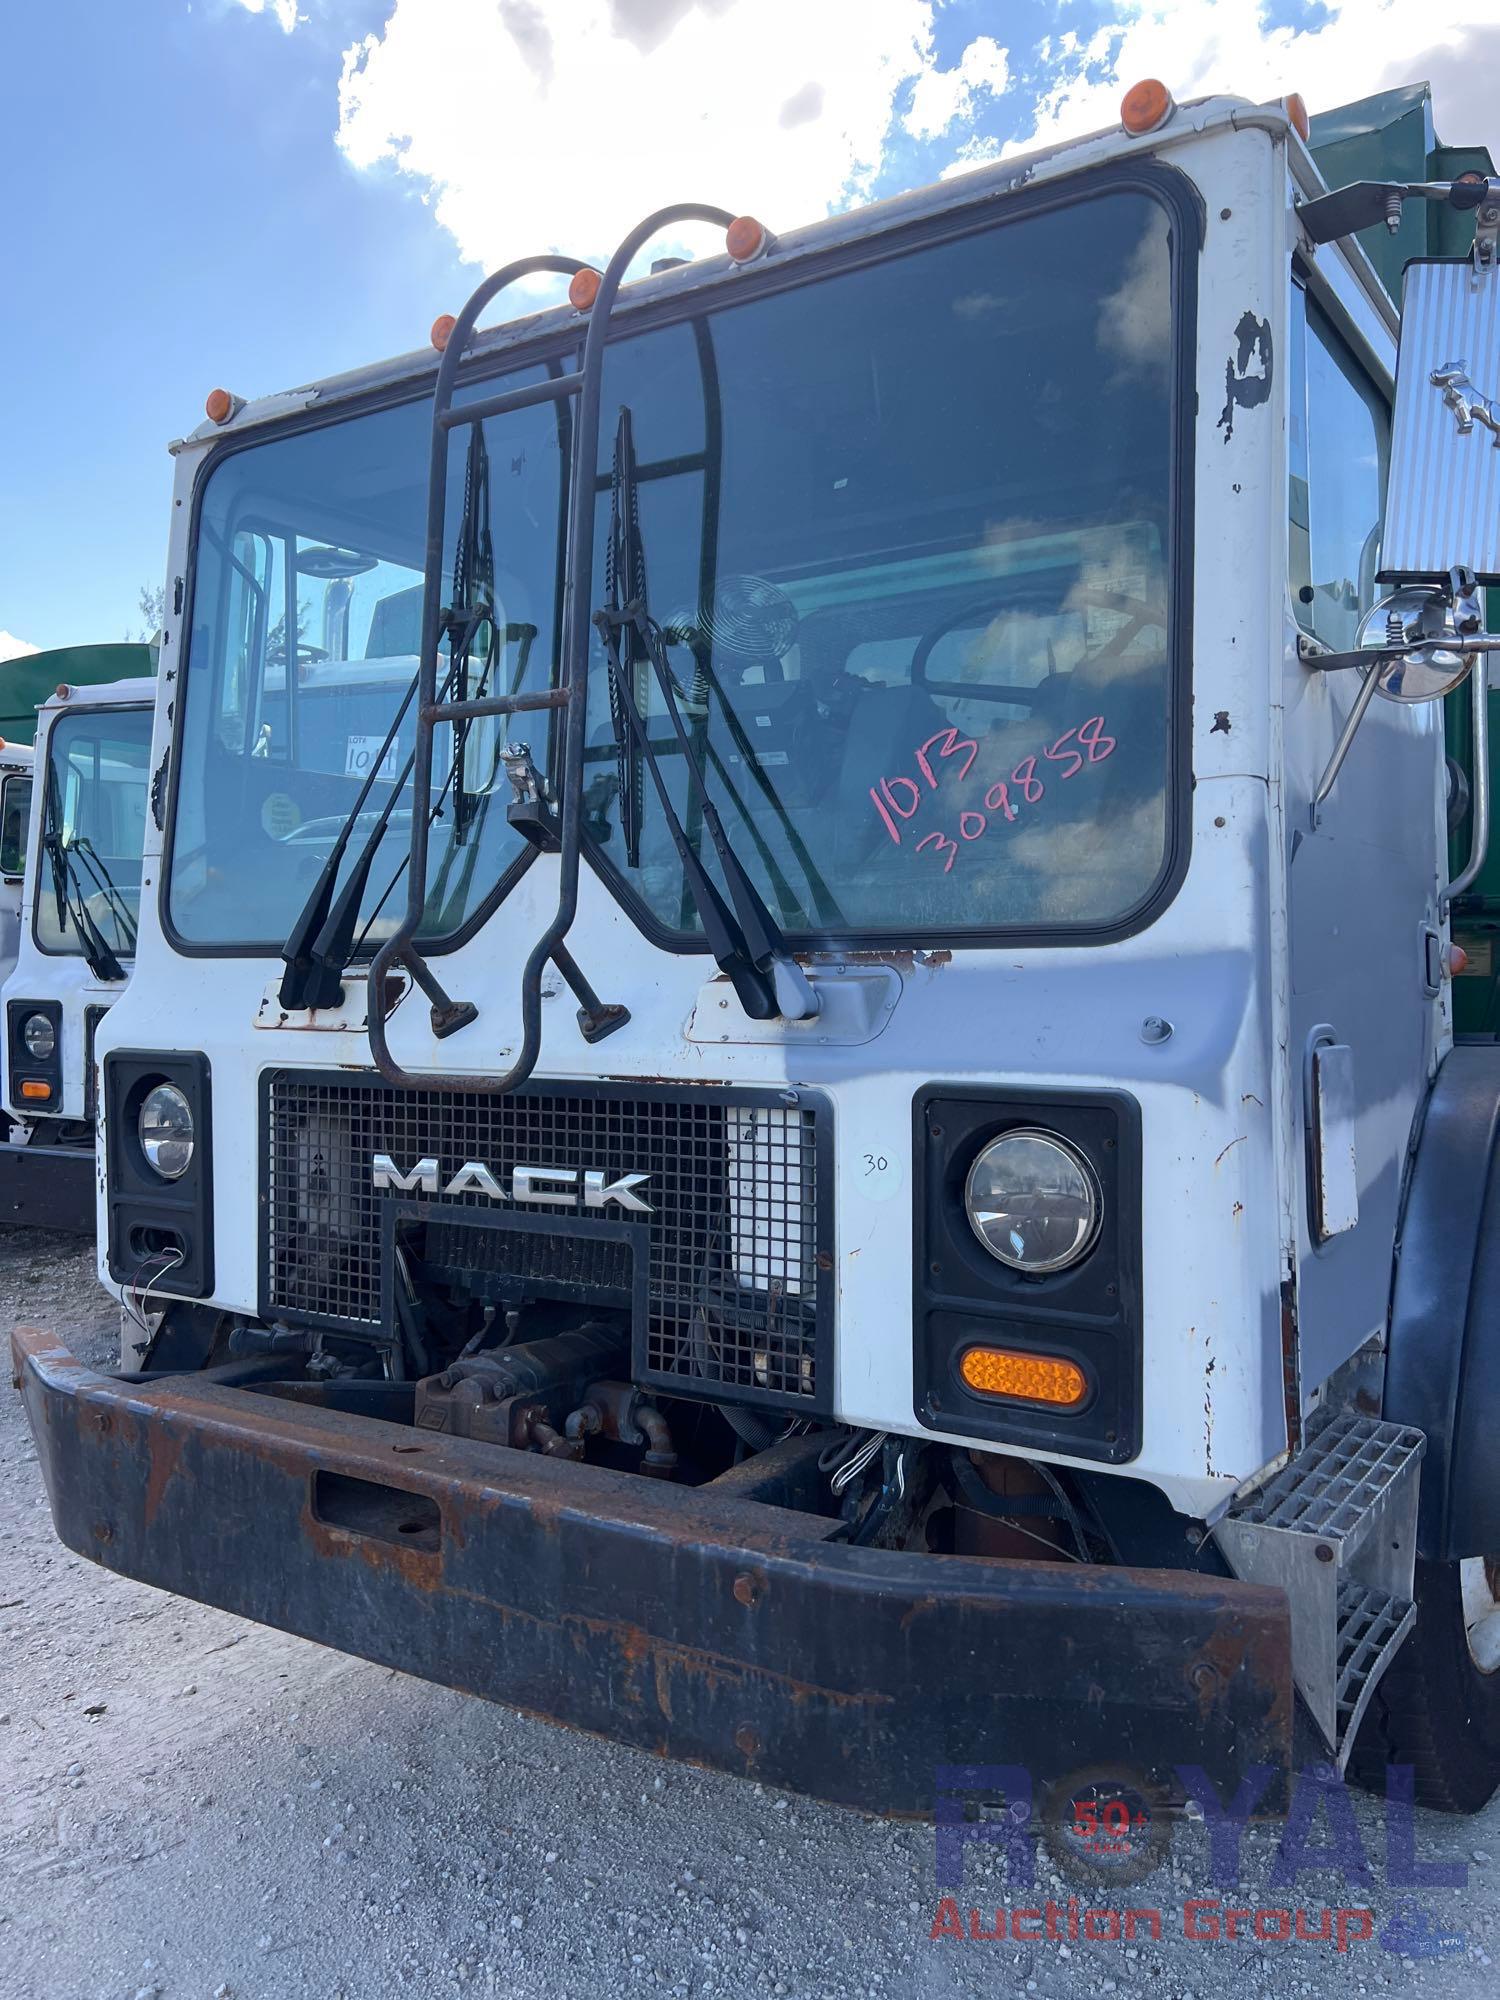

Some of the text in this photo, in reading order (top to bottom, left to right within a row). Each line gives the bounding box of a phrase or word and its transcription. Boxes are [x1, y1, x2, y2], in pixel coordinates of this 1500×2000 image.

[915, 716, 1116, 874] 309858
[372, 1154, 657, 1213] MACK
[863, 1154, 888, 1176] 30
